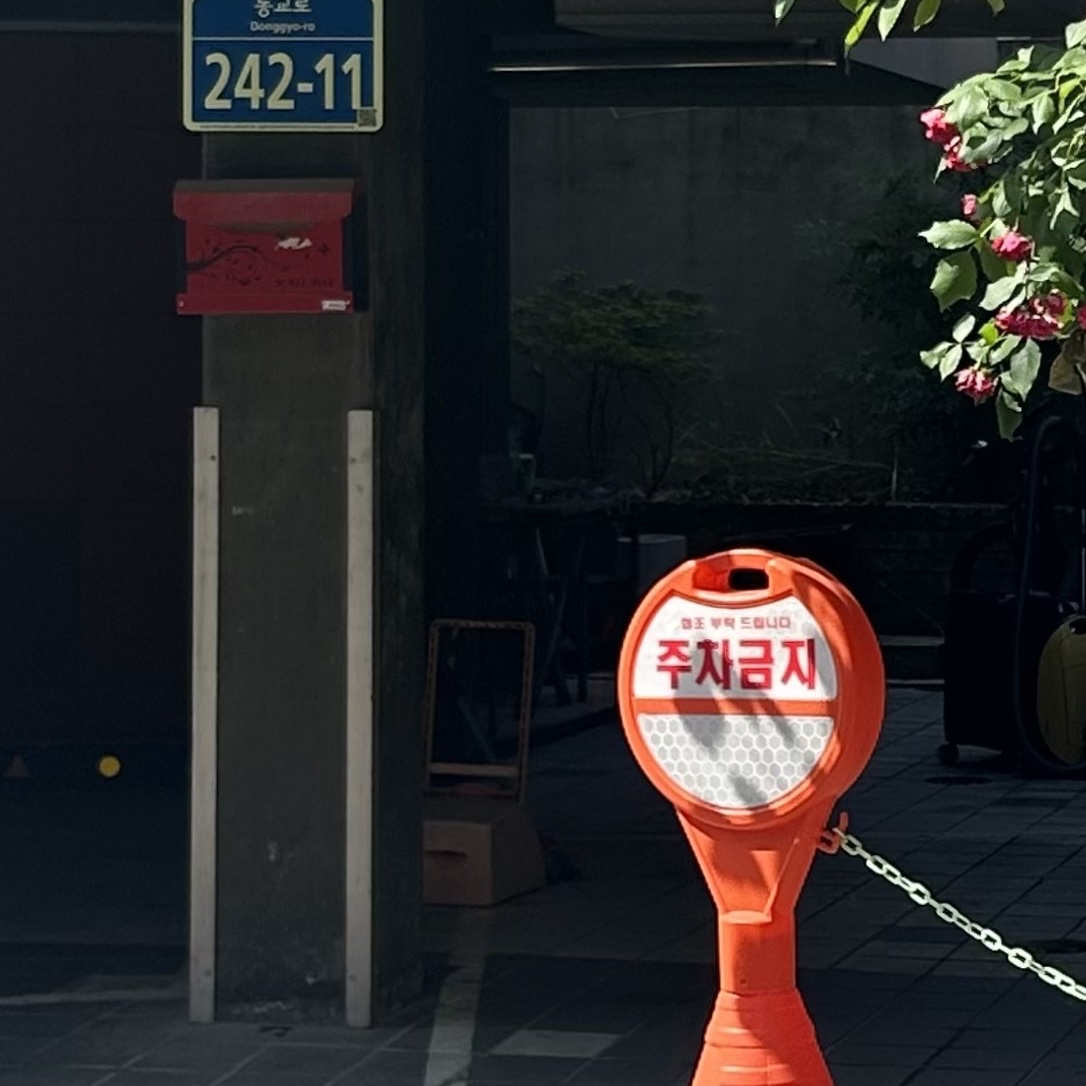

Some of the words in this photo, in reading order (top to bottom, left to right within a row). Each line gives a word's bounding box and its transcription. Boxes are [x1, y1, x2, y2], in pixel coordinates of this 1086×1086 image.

[250, 22, 316, 34] Donggyo-ro
[204, 52, 362, 110] 242-11
[712, 617, 735, 630] 부탁
[741, 617, 791, 630] 드립니다
[656, 639, 816, 690] 주차금지
